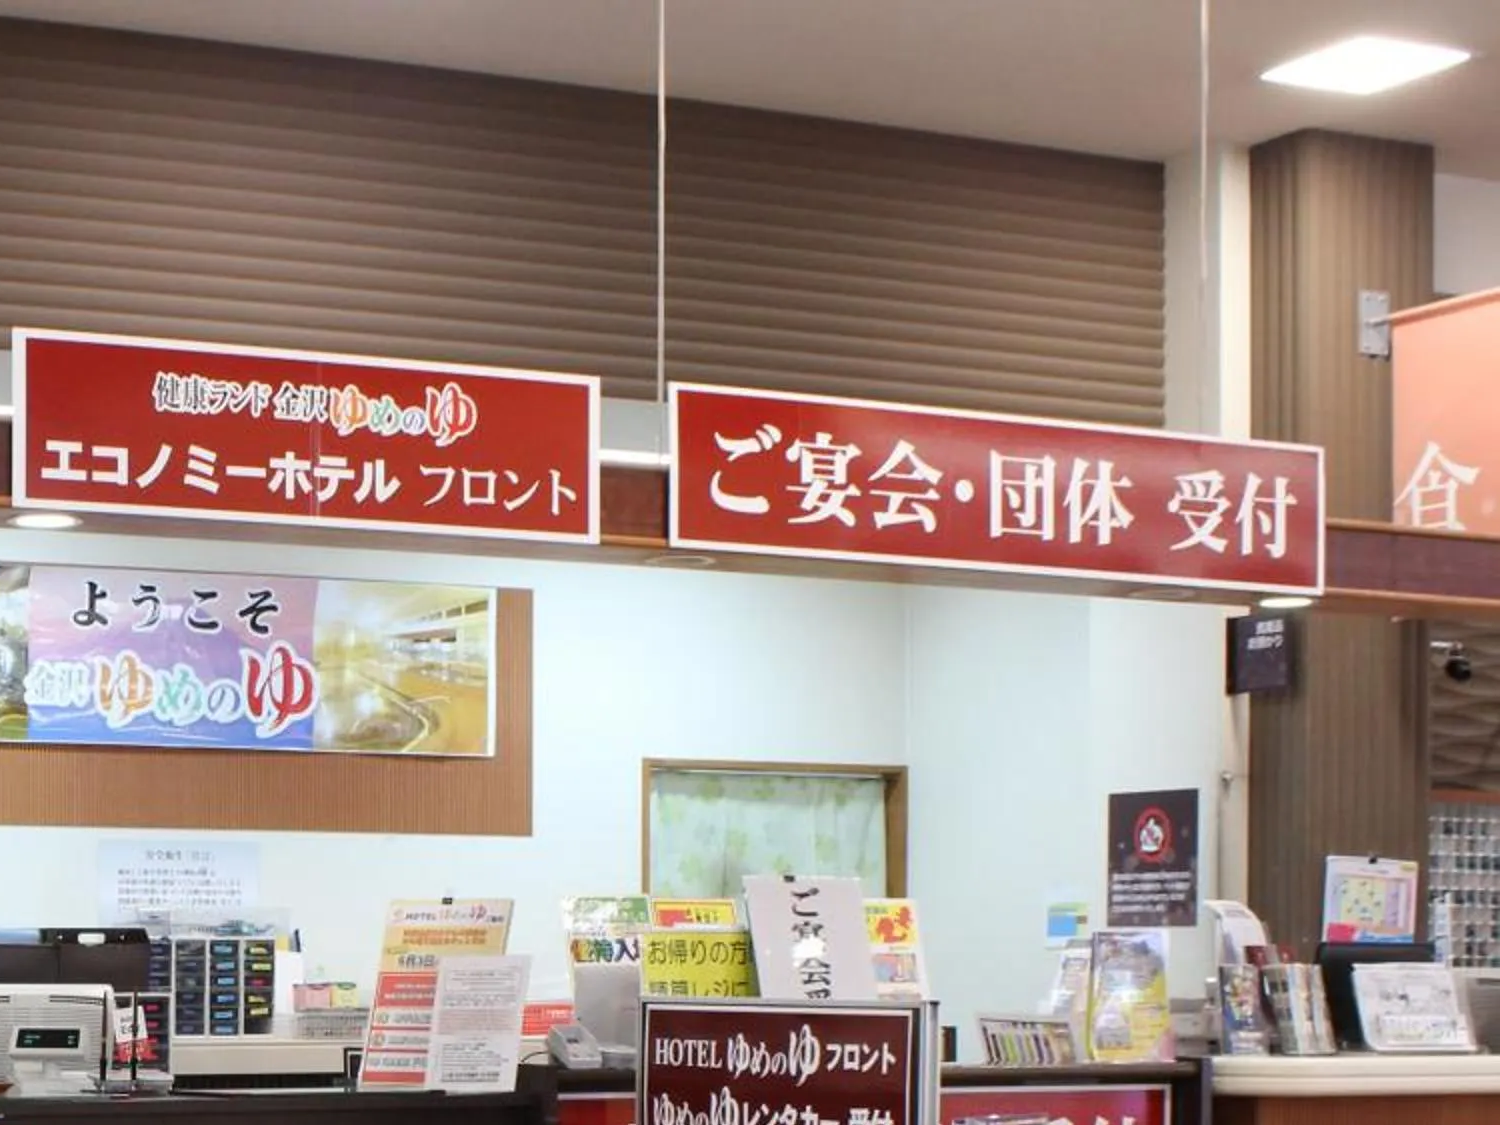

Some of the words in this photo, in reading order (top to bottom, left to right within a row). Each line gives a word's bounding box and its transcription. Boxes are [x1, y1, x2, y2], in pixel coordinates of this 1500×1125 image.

[155, 373, 268, 417] 健康ランド
[41, 439, 401, 504] エコノミーホテル
[420, 462, 576, 516] フロント
[710, 423, 1135, 546] ご宴会・団体
[1167, 468, 1298, 559] 受付
[72, 580, 280, 635] ようこそ
[654, 1037, 723, 1069] HOTEL
[727, 1023, 820, 1087] ゆめのゆ
[826, 1042, 897, 1075] フロント
